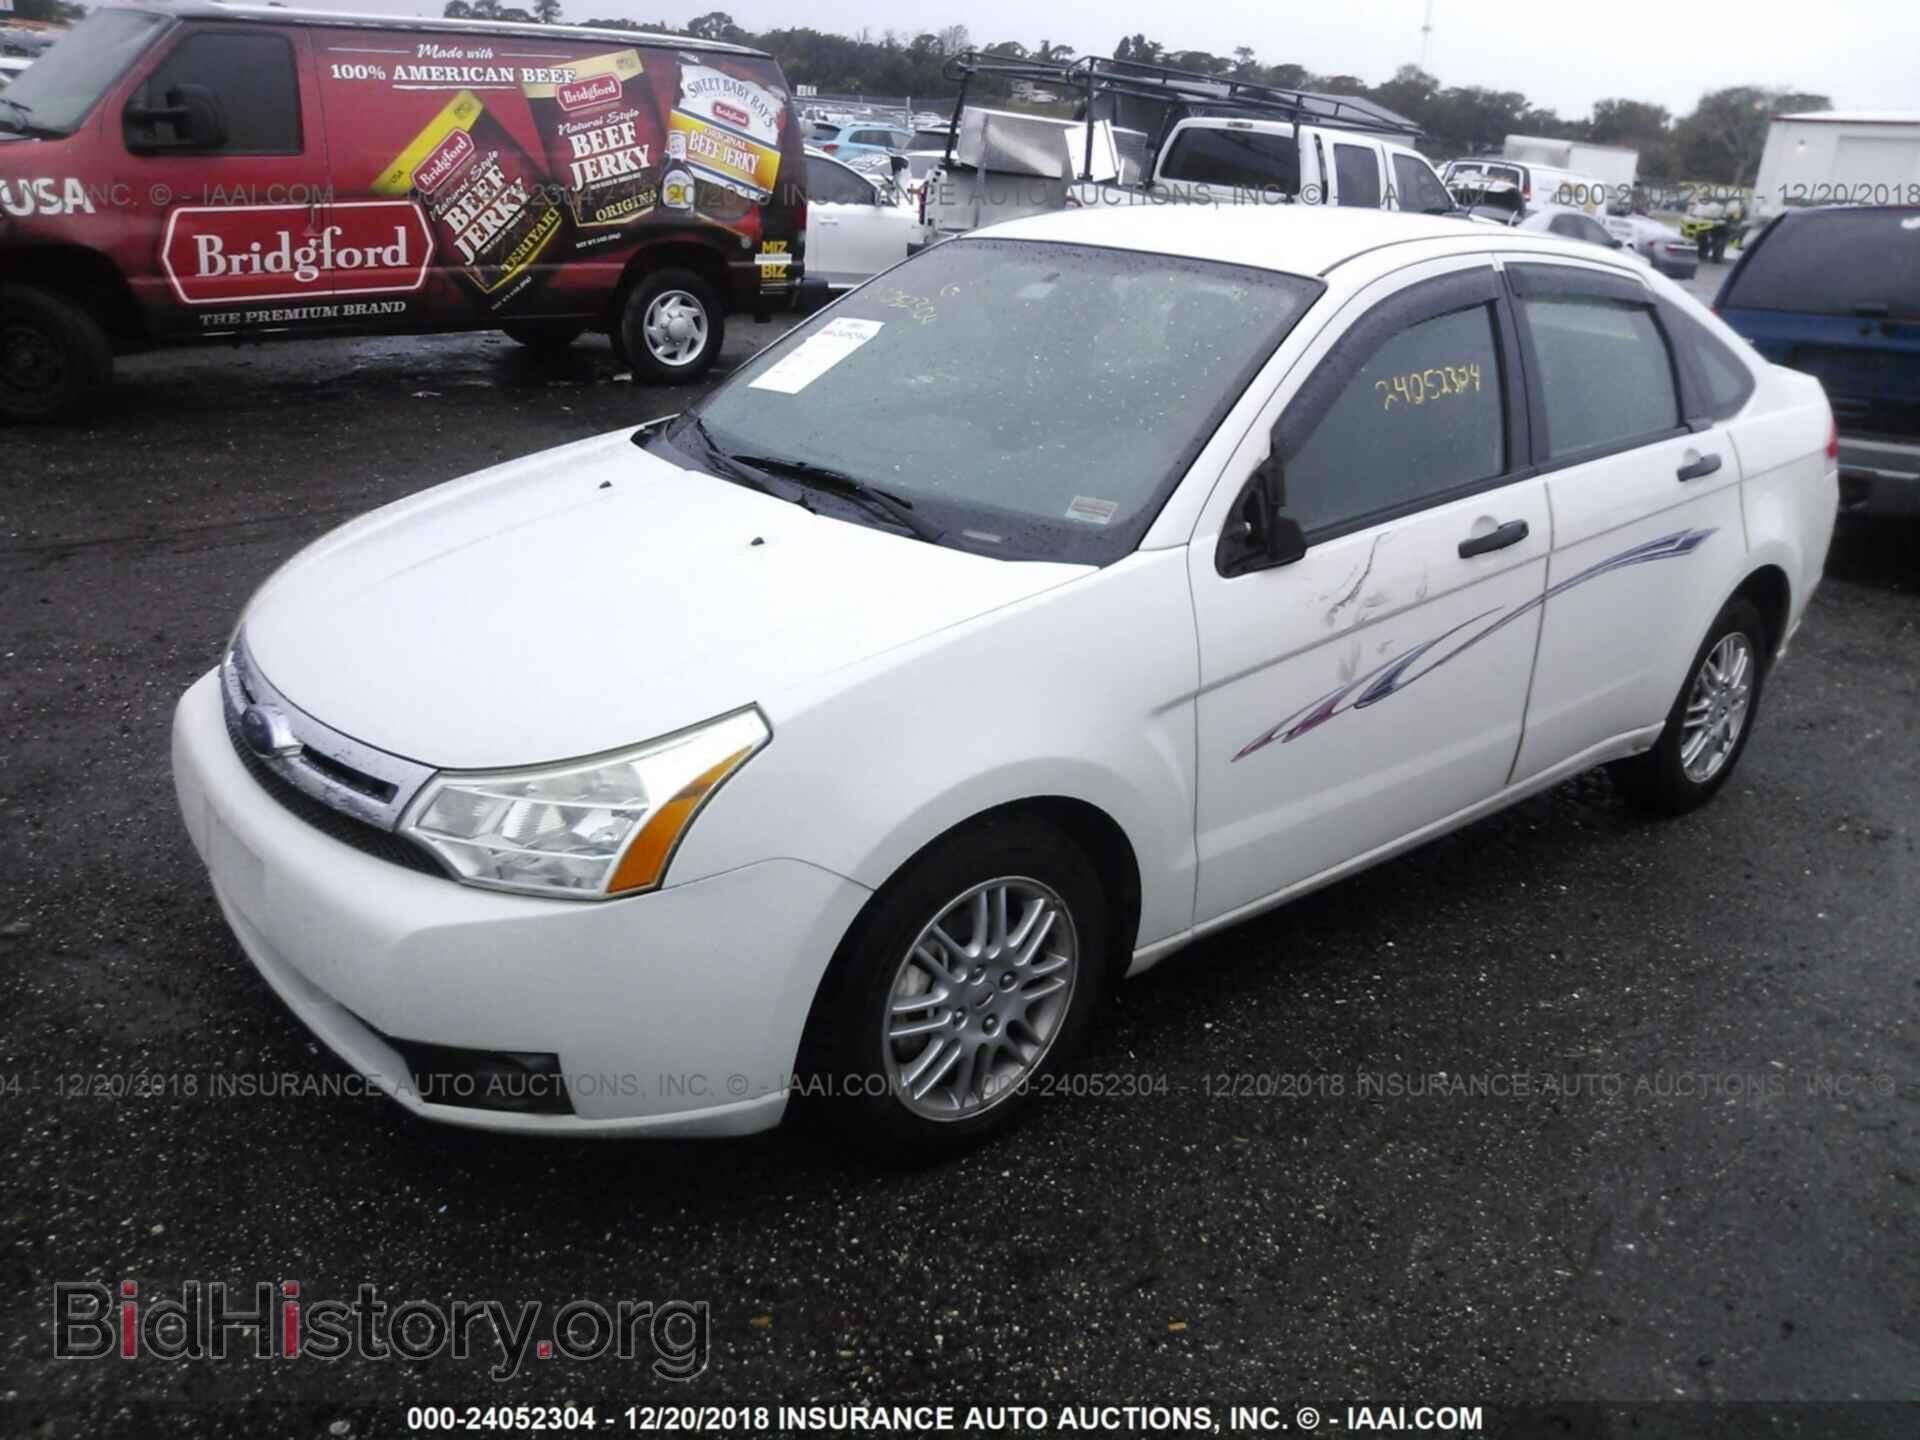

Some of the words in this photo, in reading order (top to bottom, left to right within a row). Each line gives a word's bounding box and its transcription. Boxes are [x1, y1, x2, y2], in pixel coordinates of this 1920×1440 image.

[417, 44, 463, 60] Made
[467, 47, 493, 60] with
[331, 64, 386, 80] 100%
[392, 65, 514, 82] AMERICAN
[522, 68, 577, 84] BEEF
[563, 80, 617, 104] Bridgford
[687, 77, 721, 98] SWEET
[724, 79, 750, 100] BABY
[558, 116, 604, 136] Natural
[606, 108, 640, 123] Style
[568, 121, 637, 159] BEEF
[420, 137, 468, 186] Bridgford
[569, 144, 652, 191] JERKY
[688, 129, 721, 158] BEEF
[720, 145, 760, 176] JERKY
[0, 177, 95, 216] USA
[430, 178, 470, 221] Natural
[470, 150, 499, 181] Style
[443, 164, 505, 235] BEEF
[454, 177, 531, 266] JERKY
[595, 190, 658, 222] ORIGINA
[193, 226, 410, 282] Bridgford
[500, 207, 560, 272] TERIYAKI
[761, 264, 787, 278] BIZ
[200, 313, 240, 326] THE
[245, 306, 338, 324] PREMIUM
[343, 301, 407, 316] BRAND
